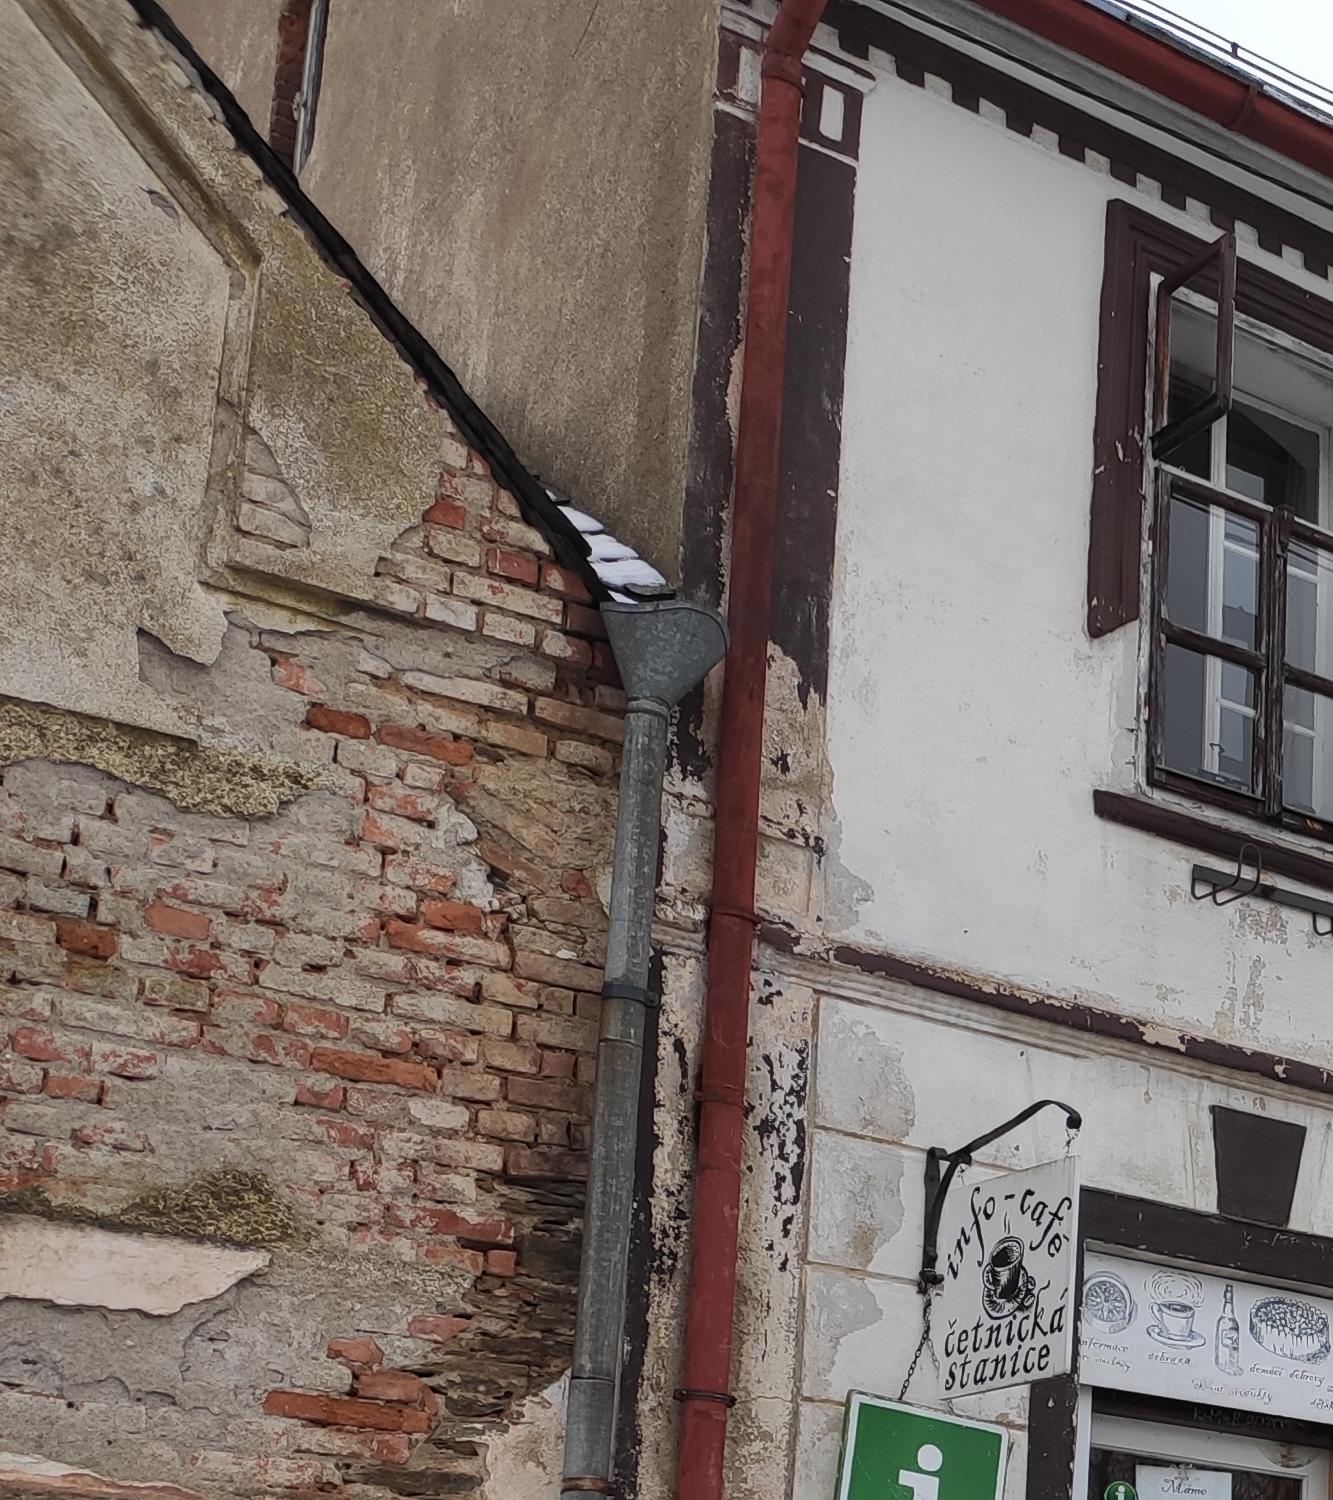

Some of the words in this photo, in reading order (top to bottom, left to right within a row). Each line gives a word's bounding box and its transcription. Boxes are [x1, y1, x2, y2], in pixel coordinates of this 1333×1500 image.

[944, 1280, 1069, 1358] četnická
[1079, 1337, 1129, 1353] nformace
[944, 1343, 1051, 1391] stanice
[1161, 1477, 1208, 1497] Máme
